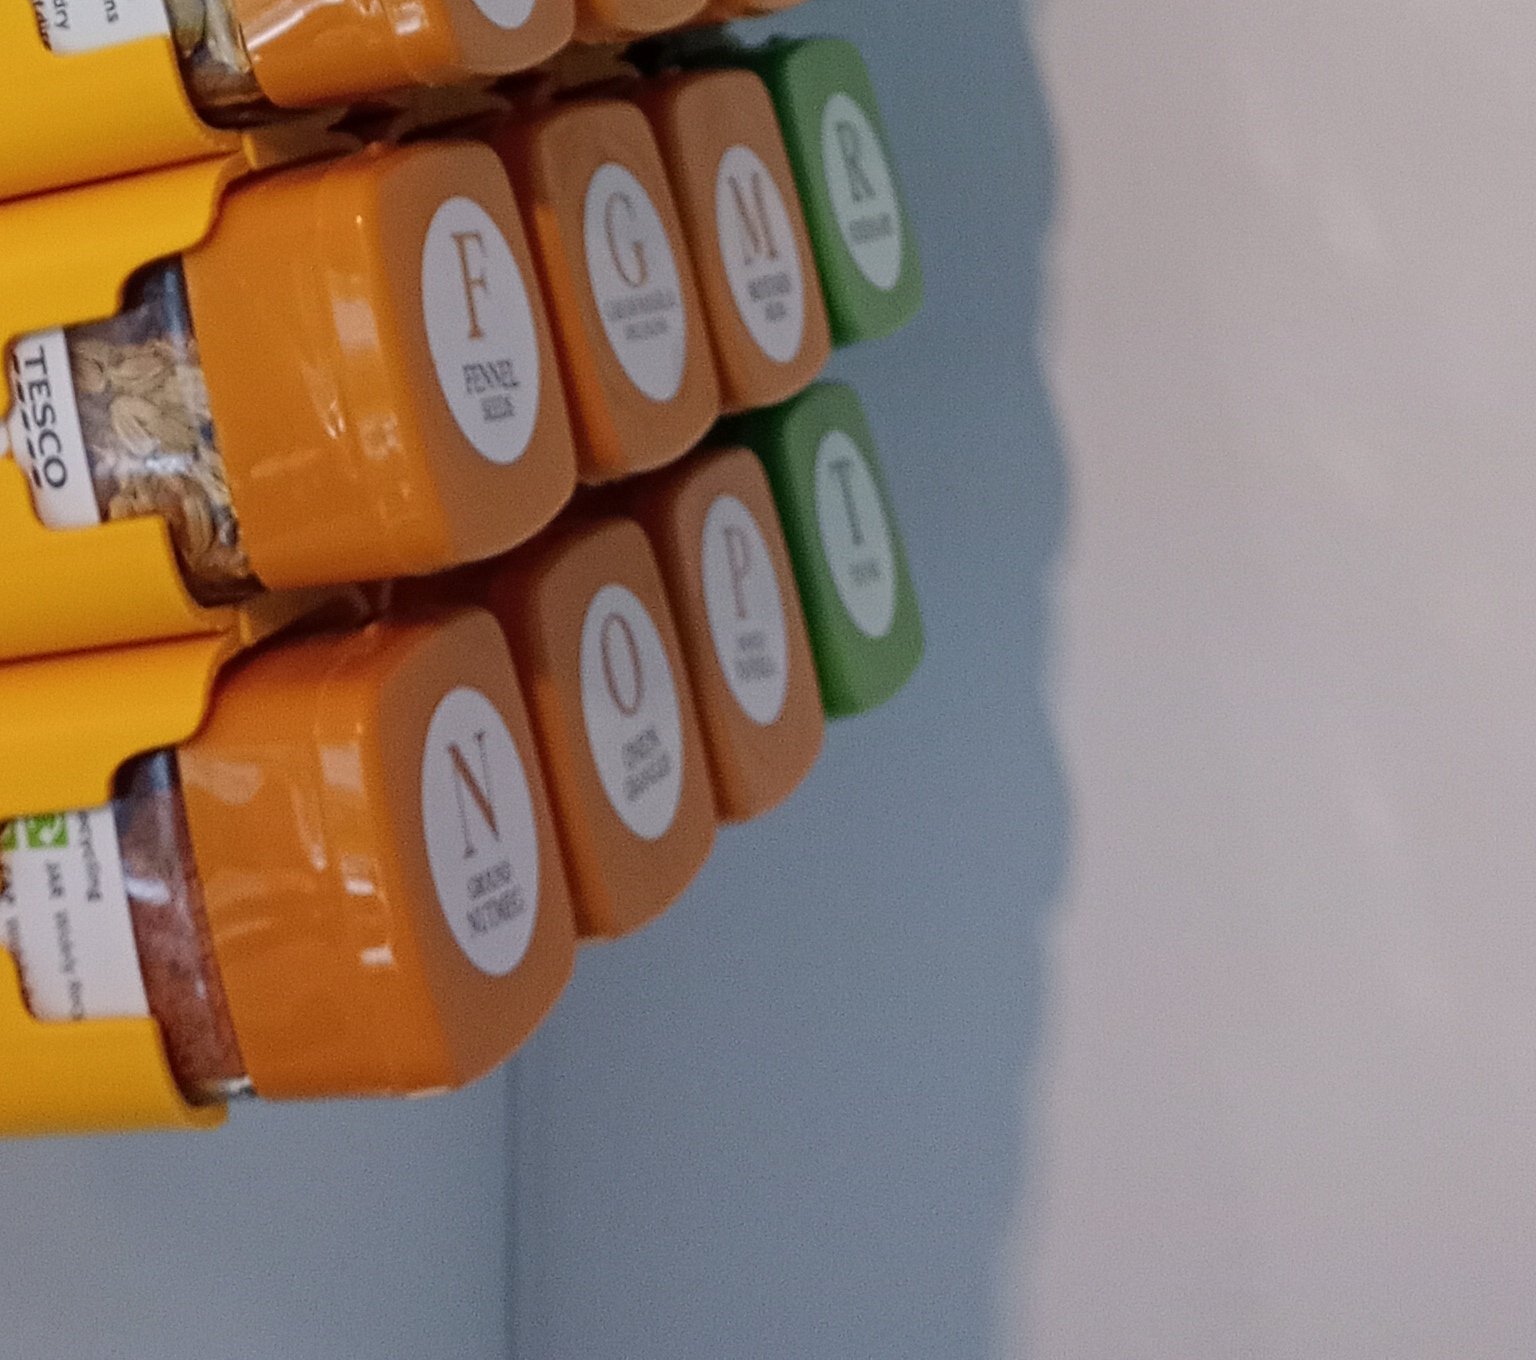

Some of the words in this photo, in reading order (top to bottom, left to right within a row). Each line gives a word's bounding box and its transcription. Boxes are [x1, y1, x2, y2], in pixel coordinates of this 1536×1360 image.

[836, 120, 876, 202] R
[605, 192, 647, 288] G
[728, 172, 778, 266] M
[451, 229, 490, 342] F
[25, 345, 68, 489] TESCO
[462, 359, 520, 394] FENNEL
[724, 526, 750, 620] P
[602, 612, 643, 717] O
[448, 728, 500, 859] N
